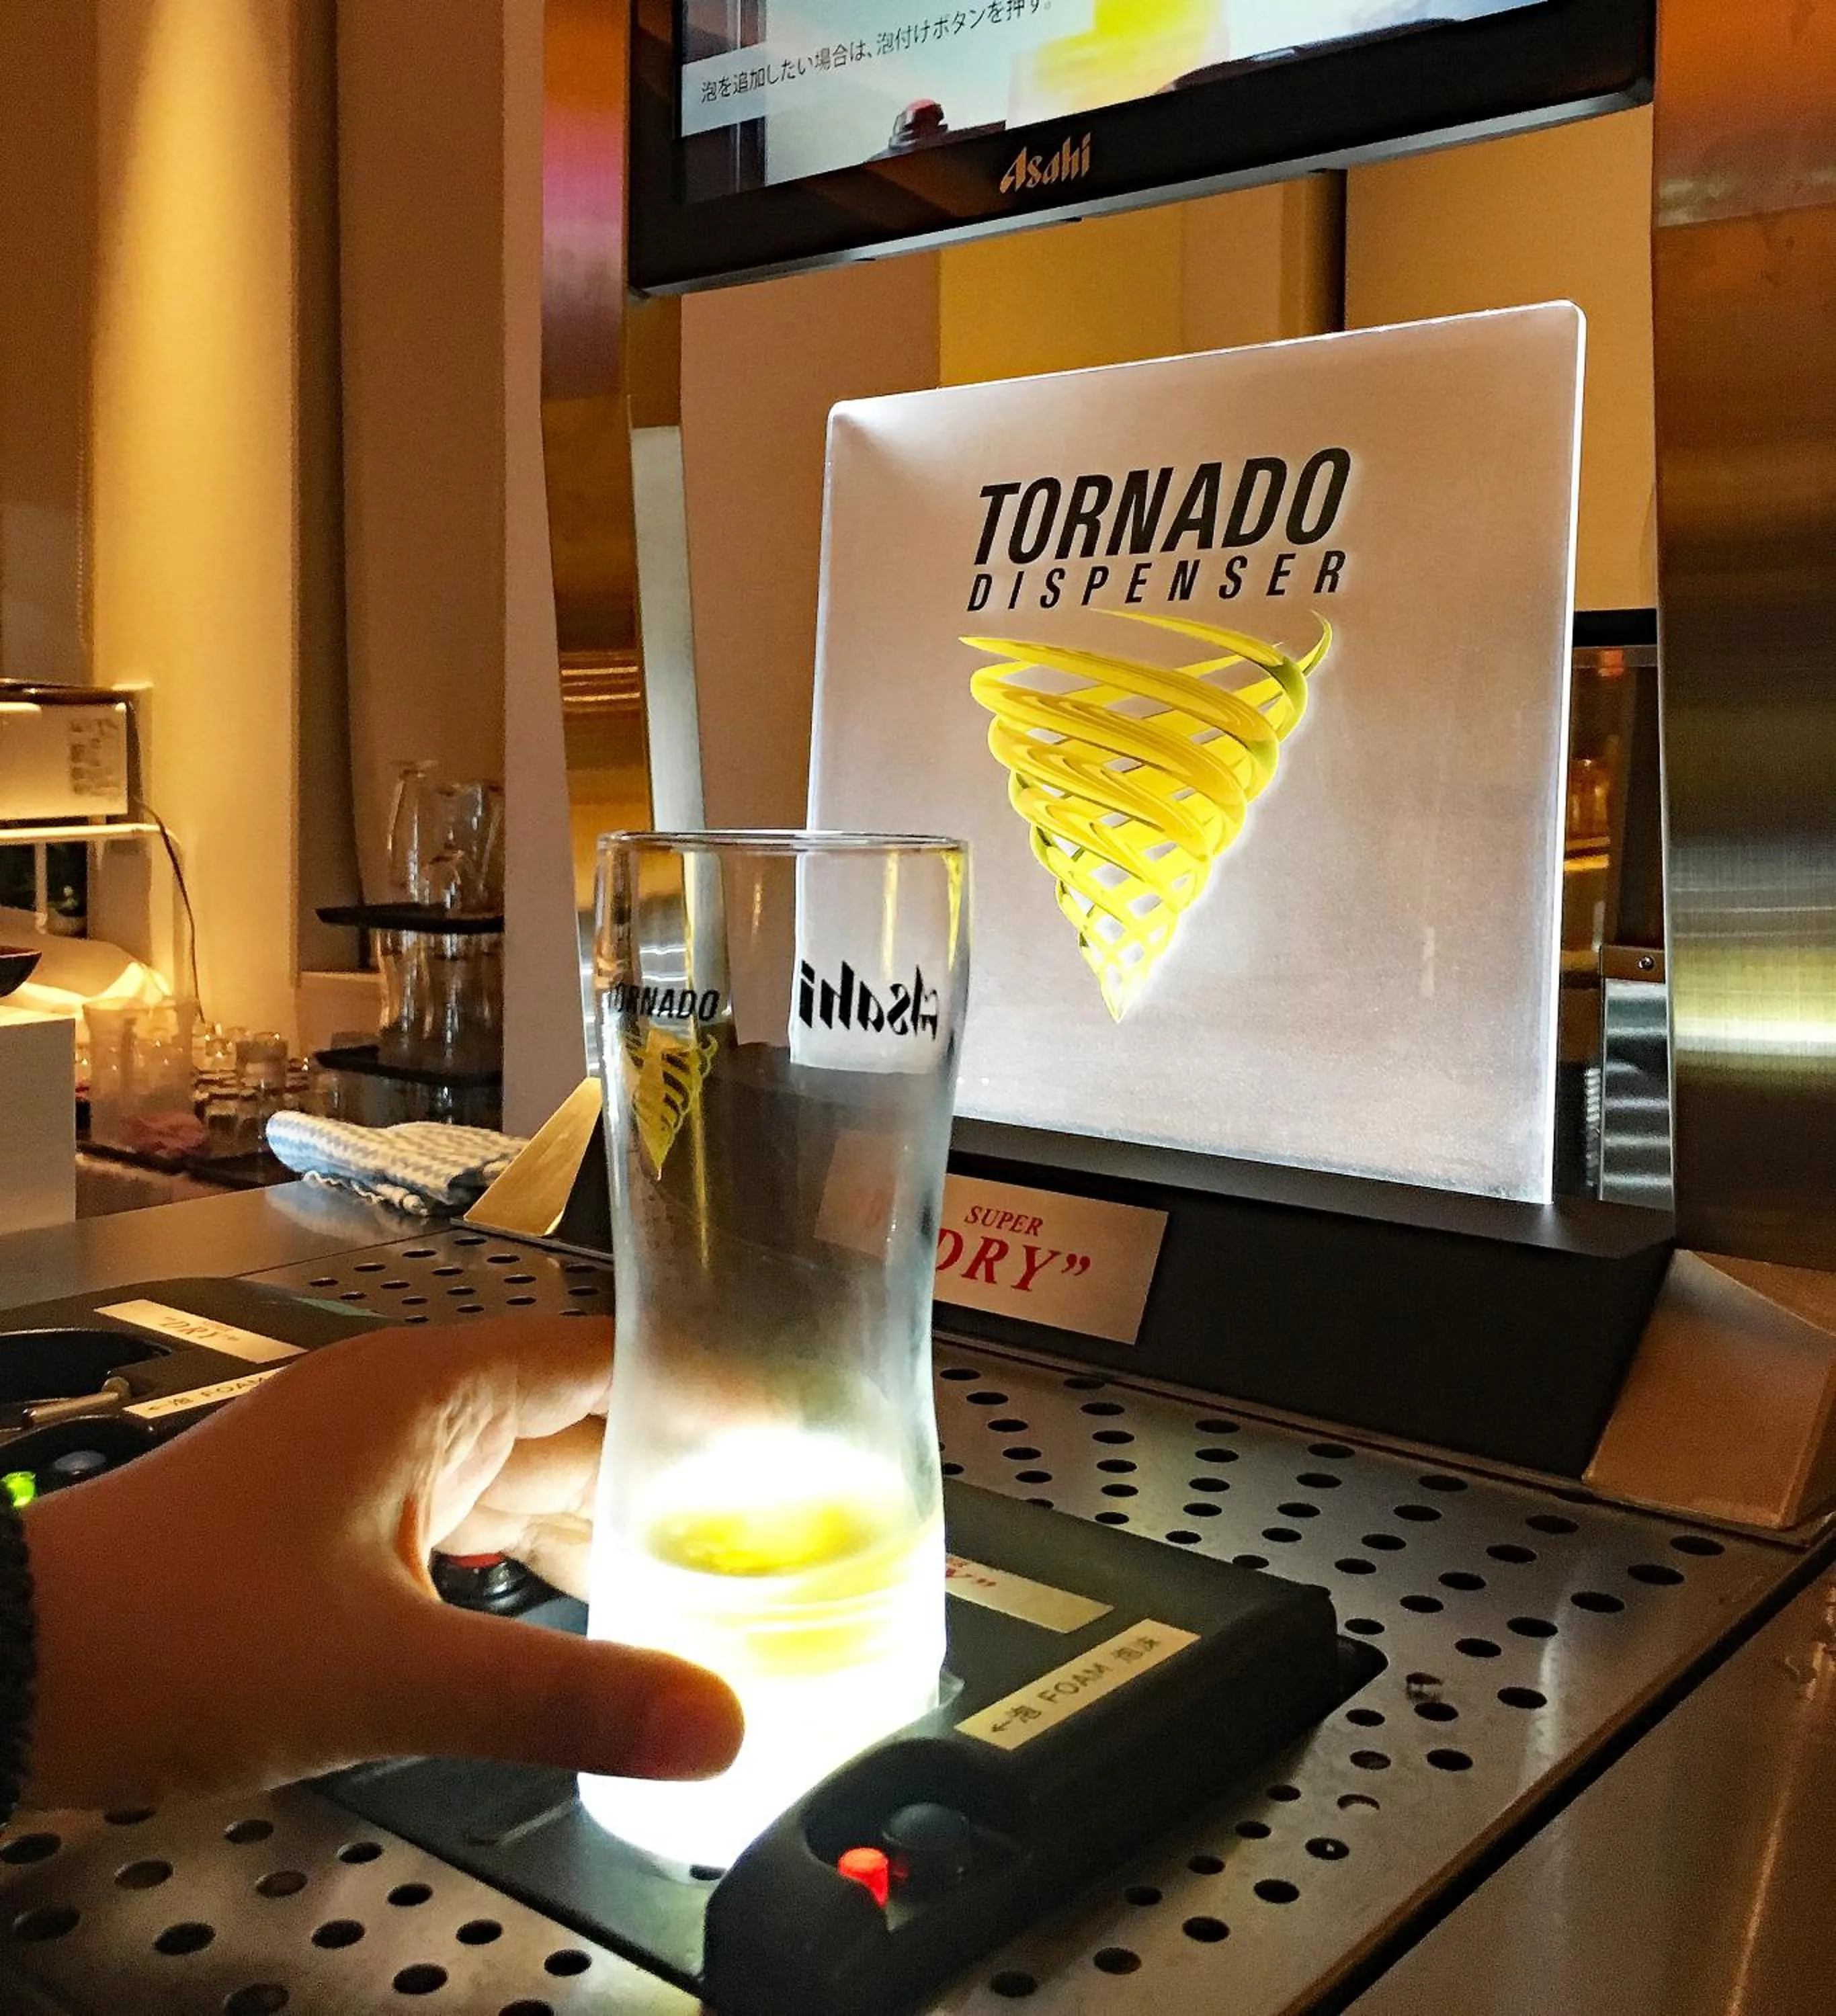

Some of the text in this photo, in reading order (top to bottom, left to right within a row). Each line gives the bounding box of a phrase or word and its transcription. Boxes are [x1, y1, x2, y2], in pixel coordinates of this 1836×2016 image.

[999, 132, 1091, 194] Asahi
[974, 447, 1351, 565] TORNADO
[968, 550, 1346, 612] DISPENSER
[964, 1205, 1044, 1237] SUPER
